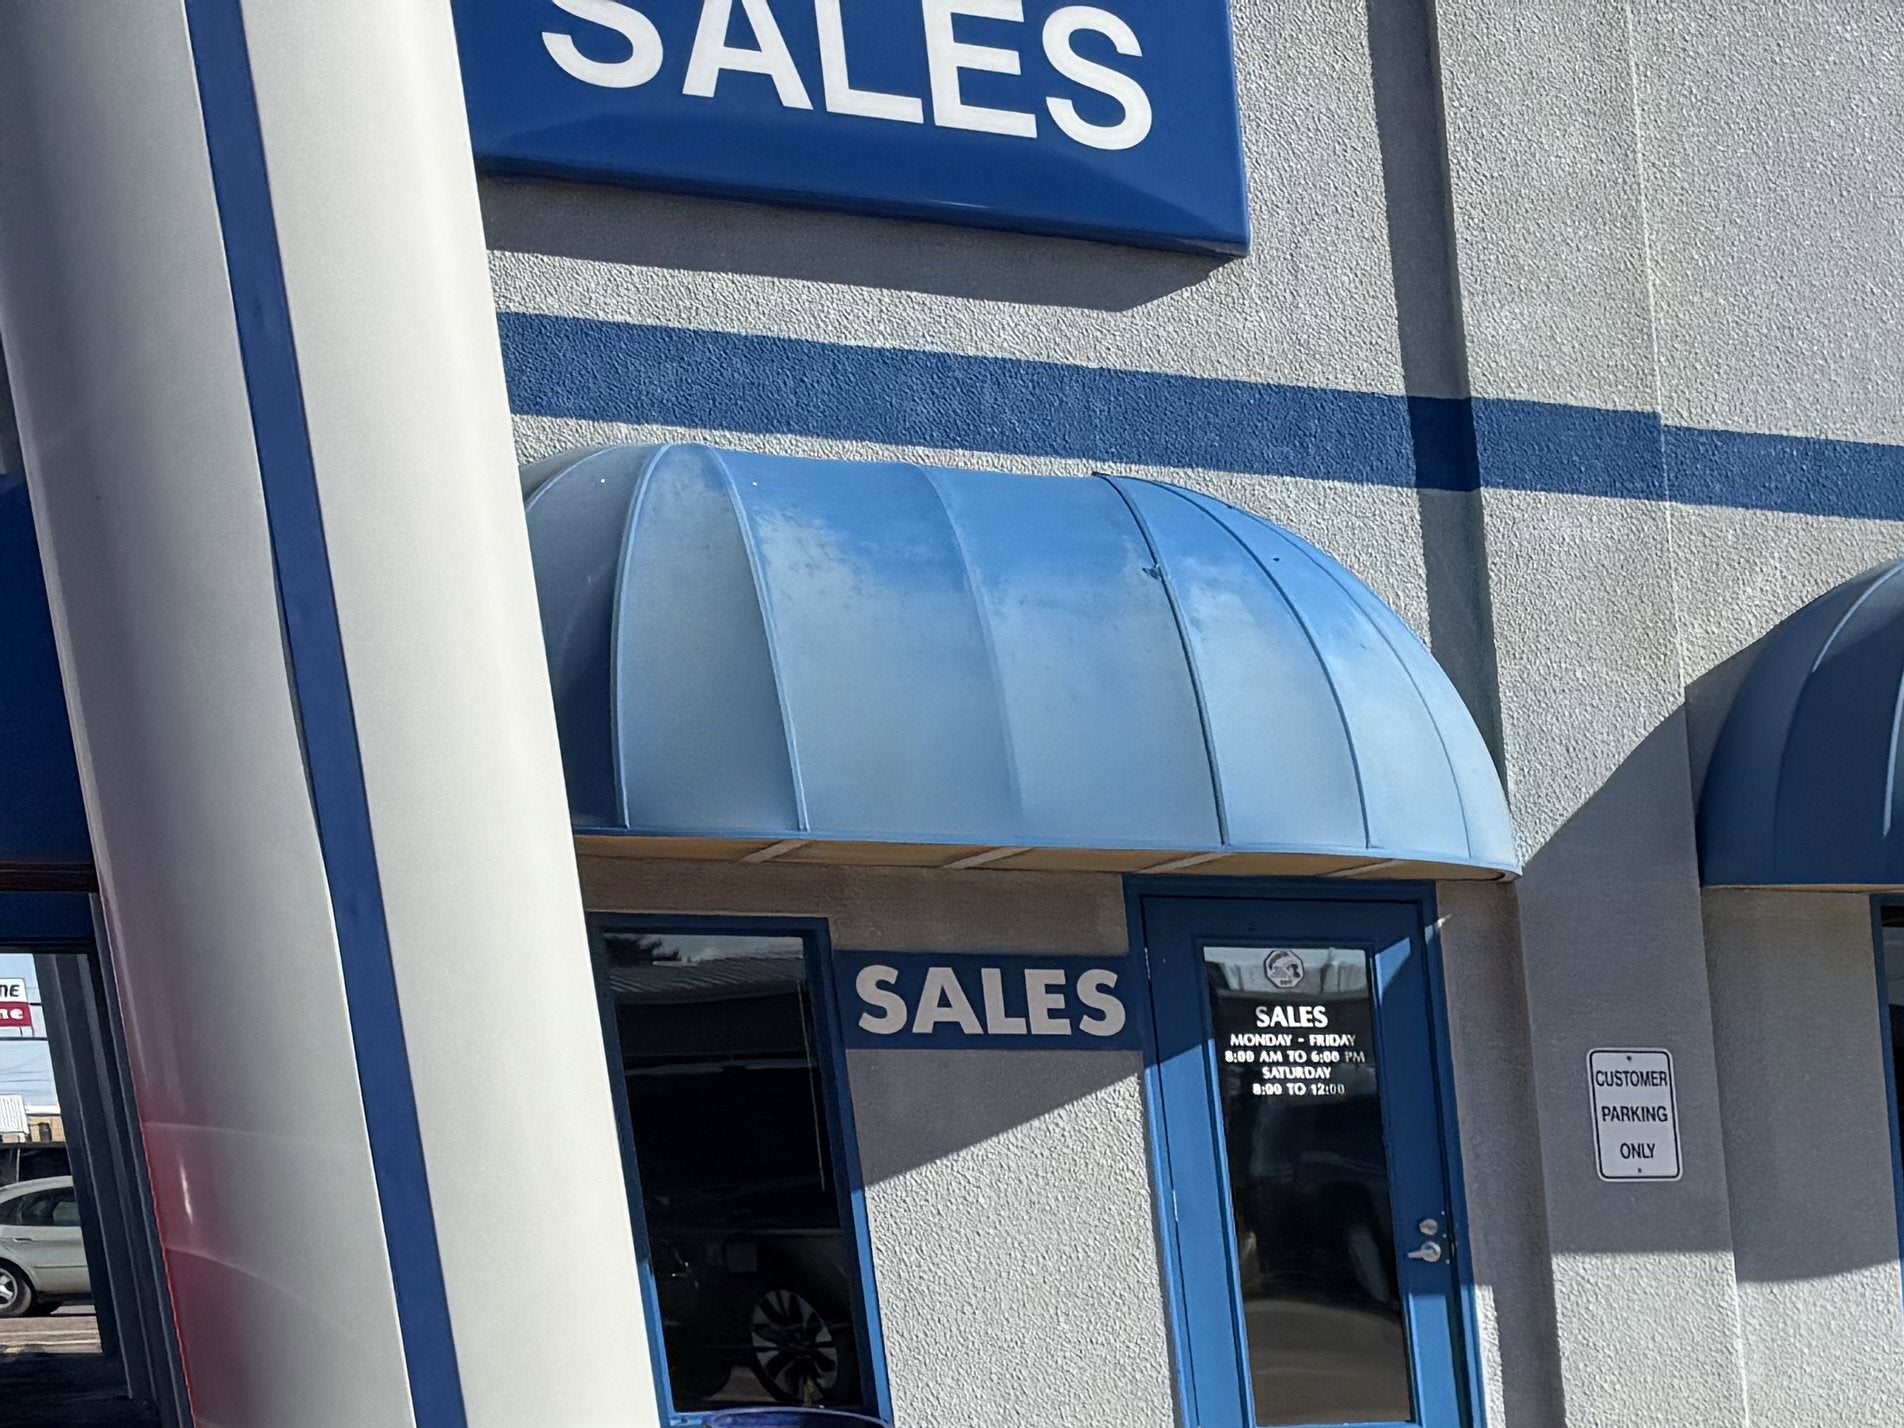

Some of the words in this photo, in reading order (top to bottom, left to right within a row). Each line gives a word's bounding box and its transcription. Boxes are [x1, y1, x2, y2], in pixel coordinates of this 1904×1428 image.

[541, 0, 1153, 150] SALES
[855, 964, 1126, 1037] SALES
[1255, 1005, 1329, 1028] SALES
[1230, 1033, 1293, 1047] MONDAY
[1309, 1034, 1356, 1047] FRIDAY
[1224, 1050, 1255, 1063] 8:00
[1259, 1050, 1283, 1063] AM
[1286, 1050, 1307, 1063] TO
[1311, 1050, 1340, 1063] 6:00
[1344, 1050, 1366, 1063] PM
[1262, 1066, 1332, 1079] SATURDAY
[1595, 1070, 1668, 1087] CUSTOMER
[1252, 1083, 1282, 1096] 8:00
[1286, 1083, 1307, 1096] TO
[1310, 1083, 1345, 1096] 12:00
[1601, 1106, 1668, 1122] PARKING
[1620, 1142, 1656, 1159] ONLY
